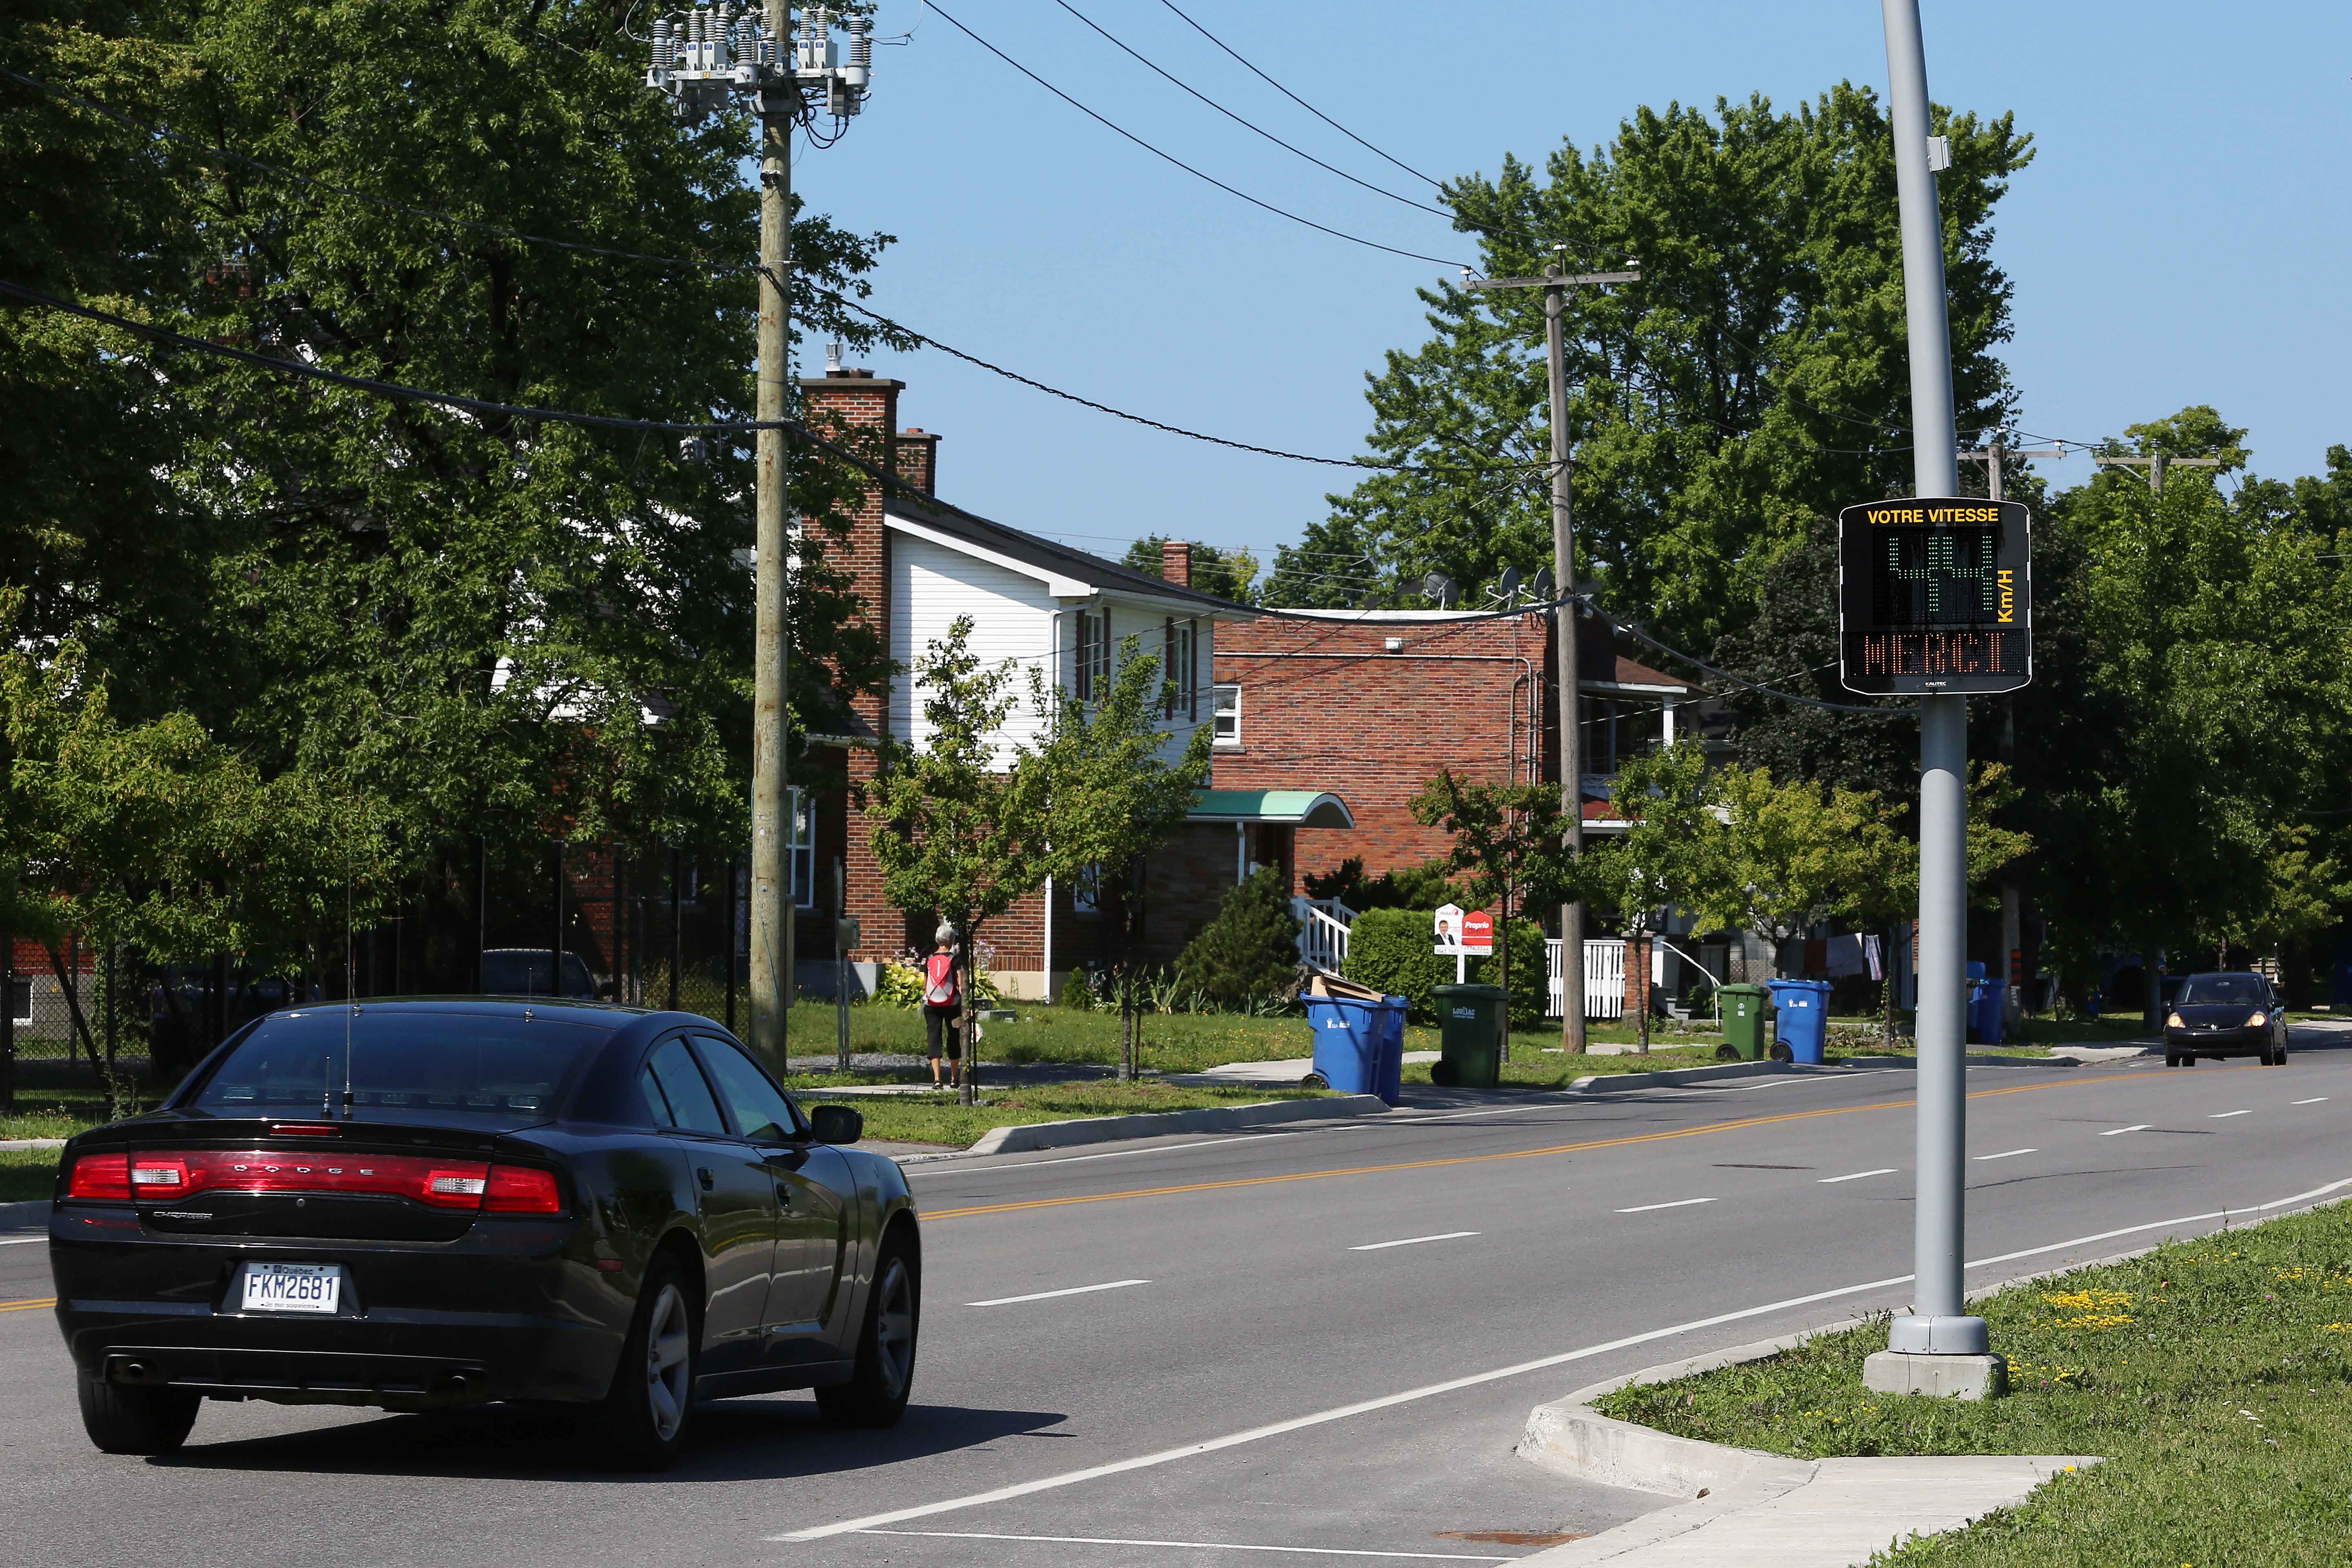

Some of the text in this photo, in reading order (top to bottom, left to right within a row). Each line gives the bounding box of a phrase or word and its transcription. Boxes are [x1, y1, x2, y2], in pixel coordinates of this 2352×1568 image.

[1867, 508, 1999, 523] VOTRE VITESSE
[1889, 536, 1993, 612] 44
[1997, 570, 2013, 622] Km/H
[1865, 632, 2006, 675] MERCI
[1465, 921, 1490, 930] Proprio
[233, 1164, 373, 1175] DODGE
[249, 1274, 332, 1300] FKM2681
